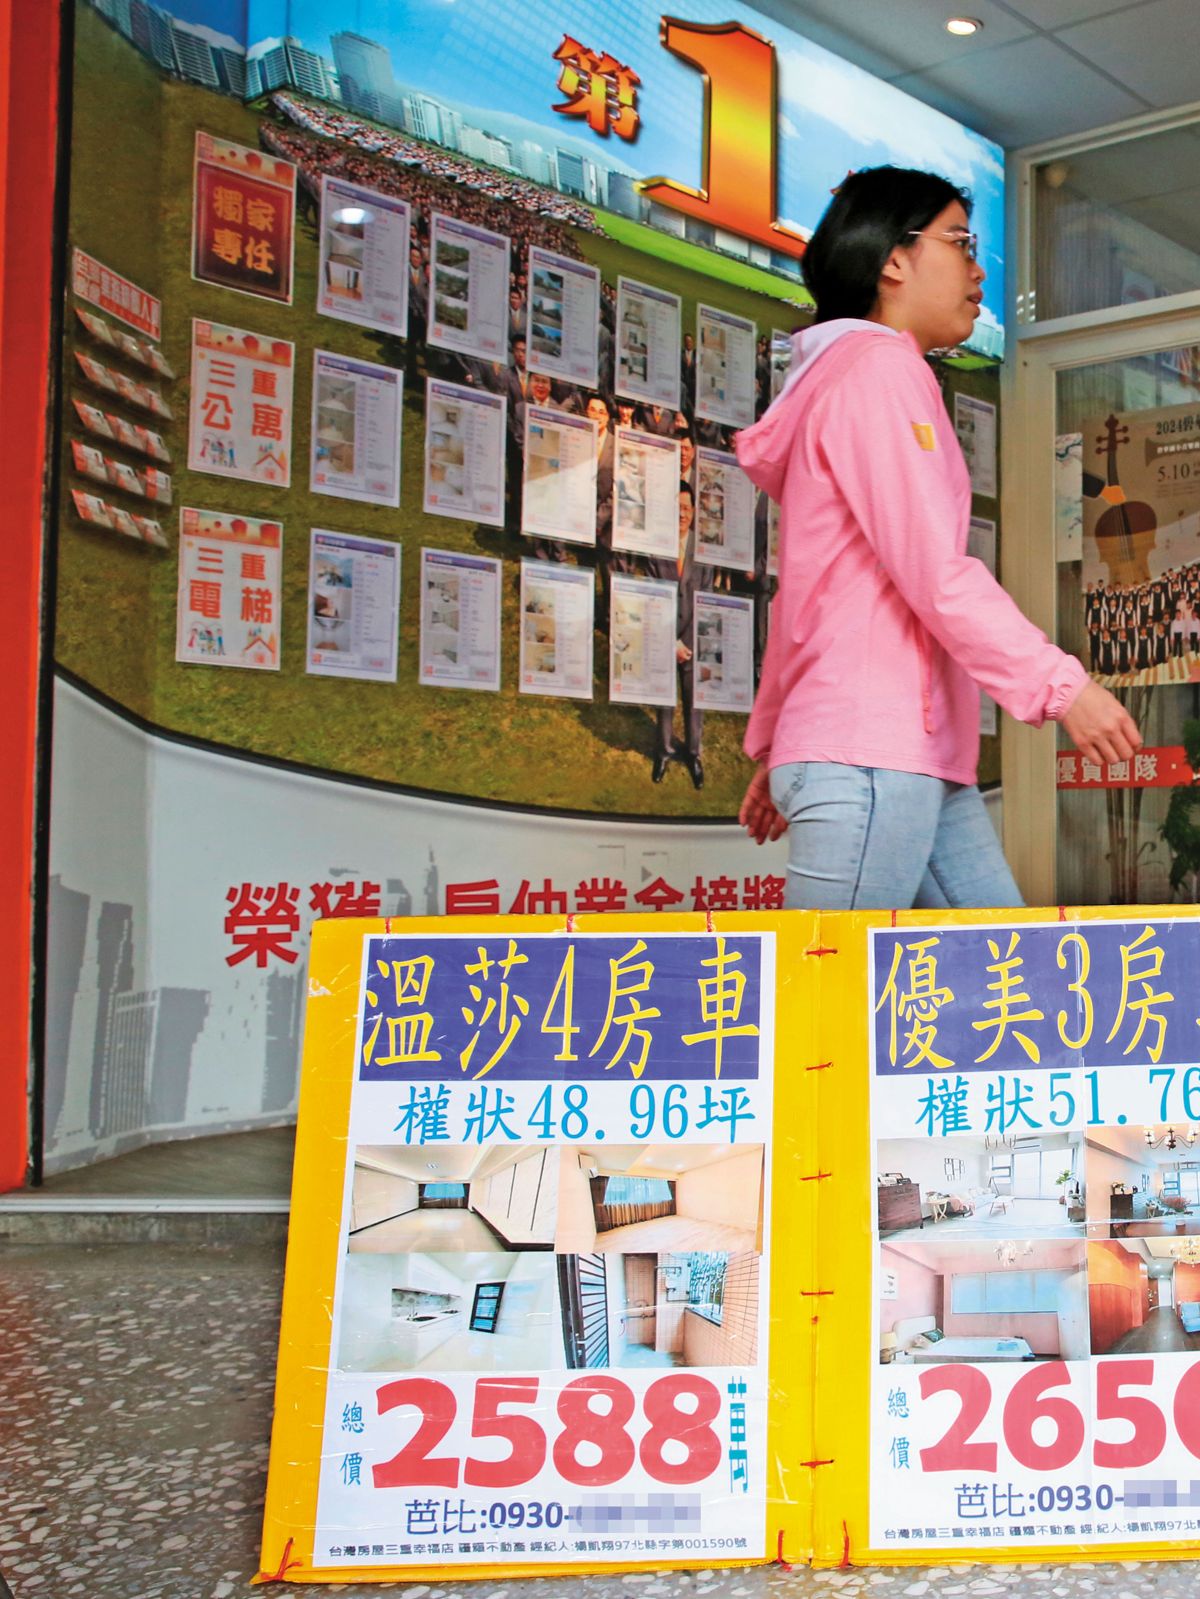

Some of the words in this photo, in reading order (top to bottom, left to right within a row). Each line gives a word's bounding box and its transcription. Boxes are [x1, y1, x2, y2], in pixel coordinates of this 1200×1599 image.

[212, 186, 276, 233] 獨家
[211, 227, 275, 275] 專任
[208, 359, 277, 398] 三重
[202, 391, 284, 442] 公寓
[1157, 463, 1191, 483] 5.10
[197, 547, 266, 581] 三重
[189, 579, 273, 625] 電梯
[371, 1373, 722, 1489] 2588
